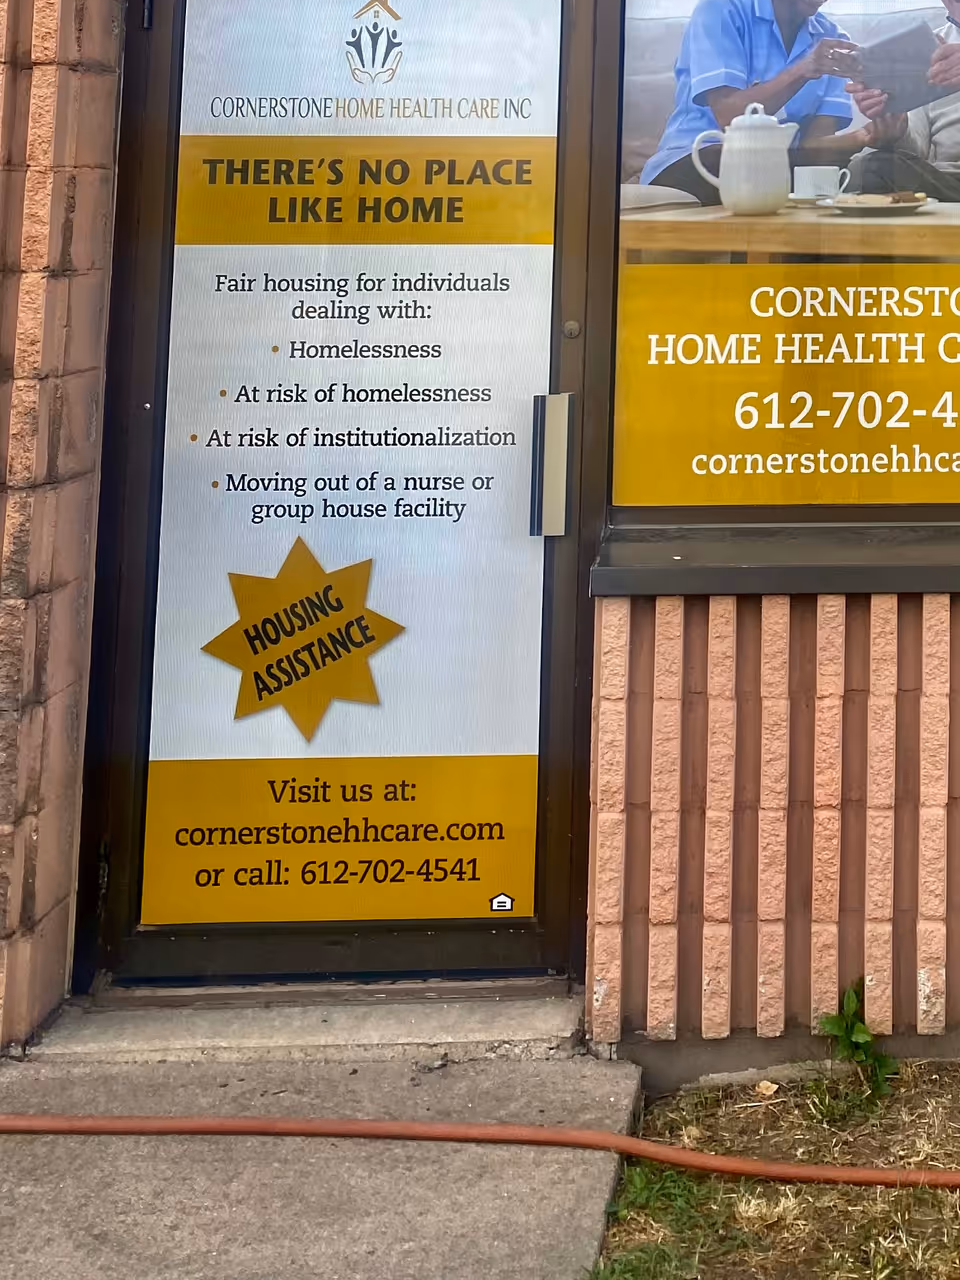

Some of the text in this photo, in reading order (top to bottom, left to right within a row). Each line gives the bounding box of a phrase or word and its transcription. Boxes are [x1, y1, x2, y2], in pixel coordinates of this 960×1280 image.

[389, 96, 453, 118] HEALTH
[457, 96, 500, 118] CARE
[503, 96, 532, 118] INC
[202, 157, 533, 185] THERE'S NO PLACE
[268, 195, 465, 222] LIKE HOME
[214, 272, 510, 298] Fair housing for individuals
[291, 299, 432, 323] dealing with:
[289, 339, 442, 359] Homelessness
[648, 333, 761, 364] HOME
[774, 331, 925, 364] HEALTH
[234, 382, 492, 403] At risk of homelessness
[205, 425, 517, 447] At risk of institutionalization
[225, 471, 495, 497] Moving out of a nurse or
[251, 496, 467, 522] group house facility
[243, 582, 344, 654] HOUSING
[252, 613, 375, 700] ASSISTANCE
[268, 777, 417, 802] Visit us at:
[175, 817, 505, 846] cornerstonehhcare.com
[194, 856, 481, 885] or call: 612-702-4541
